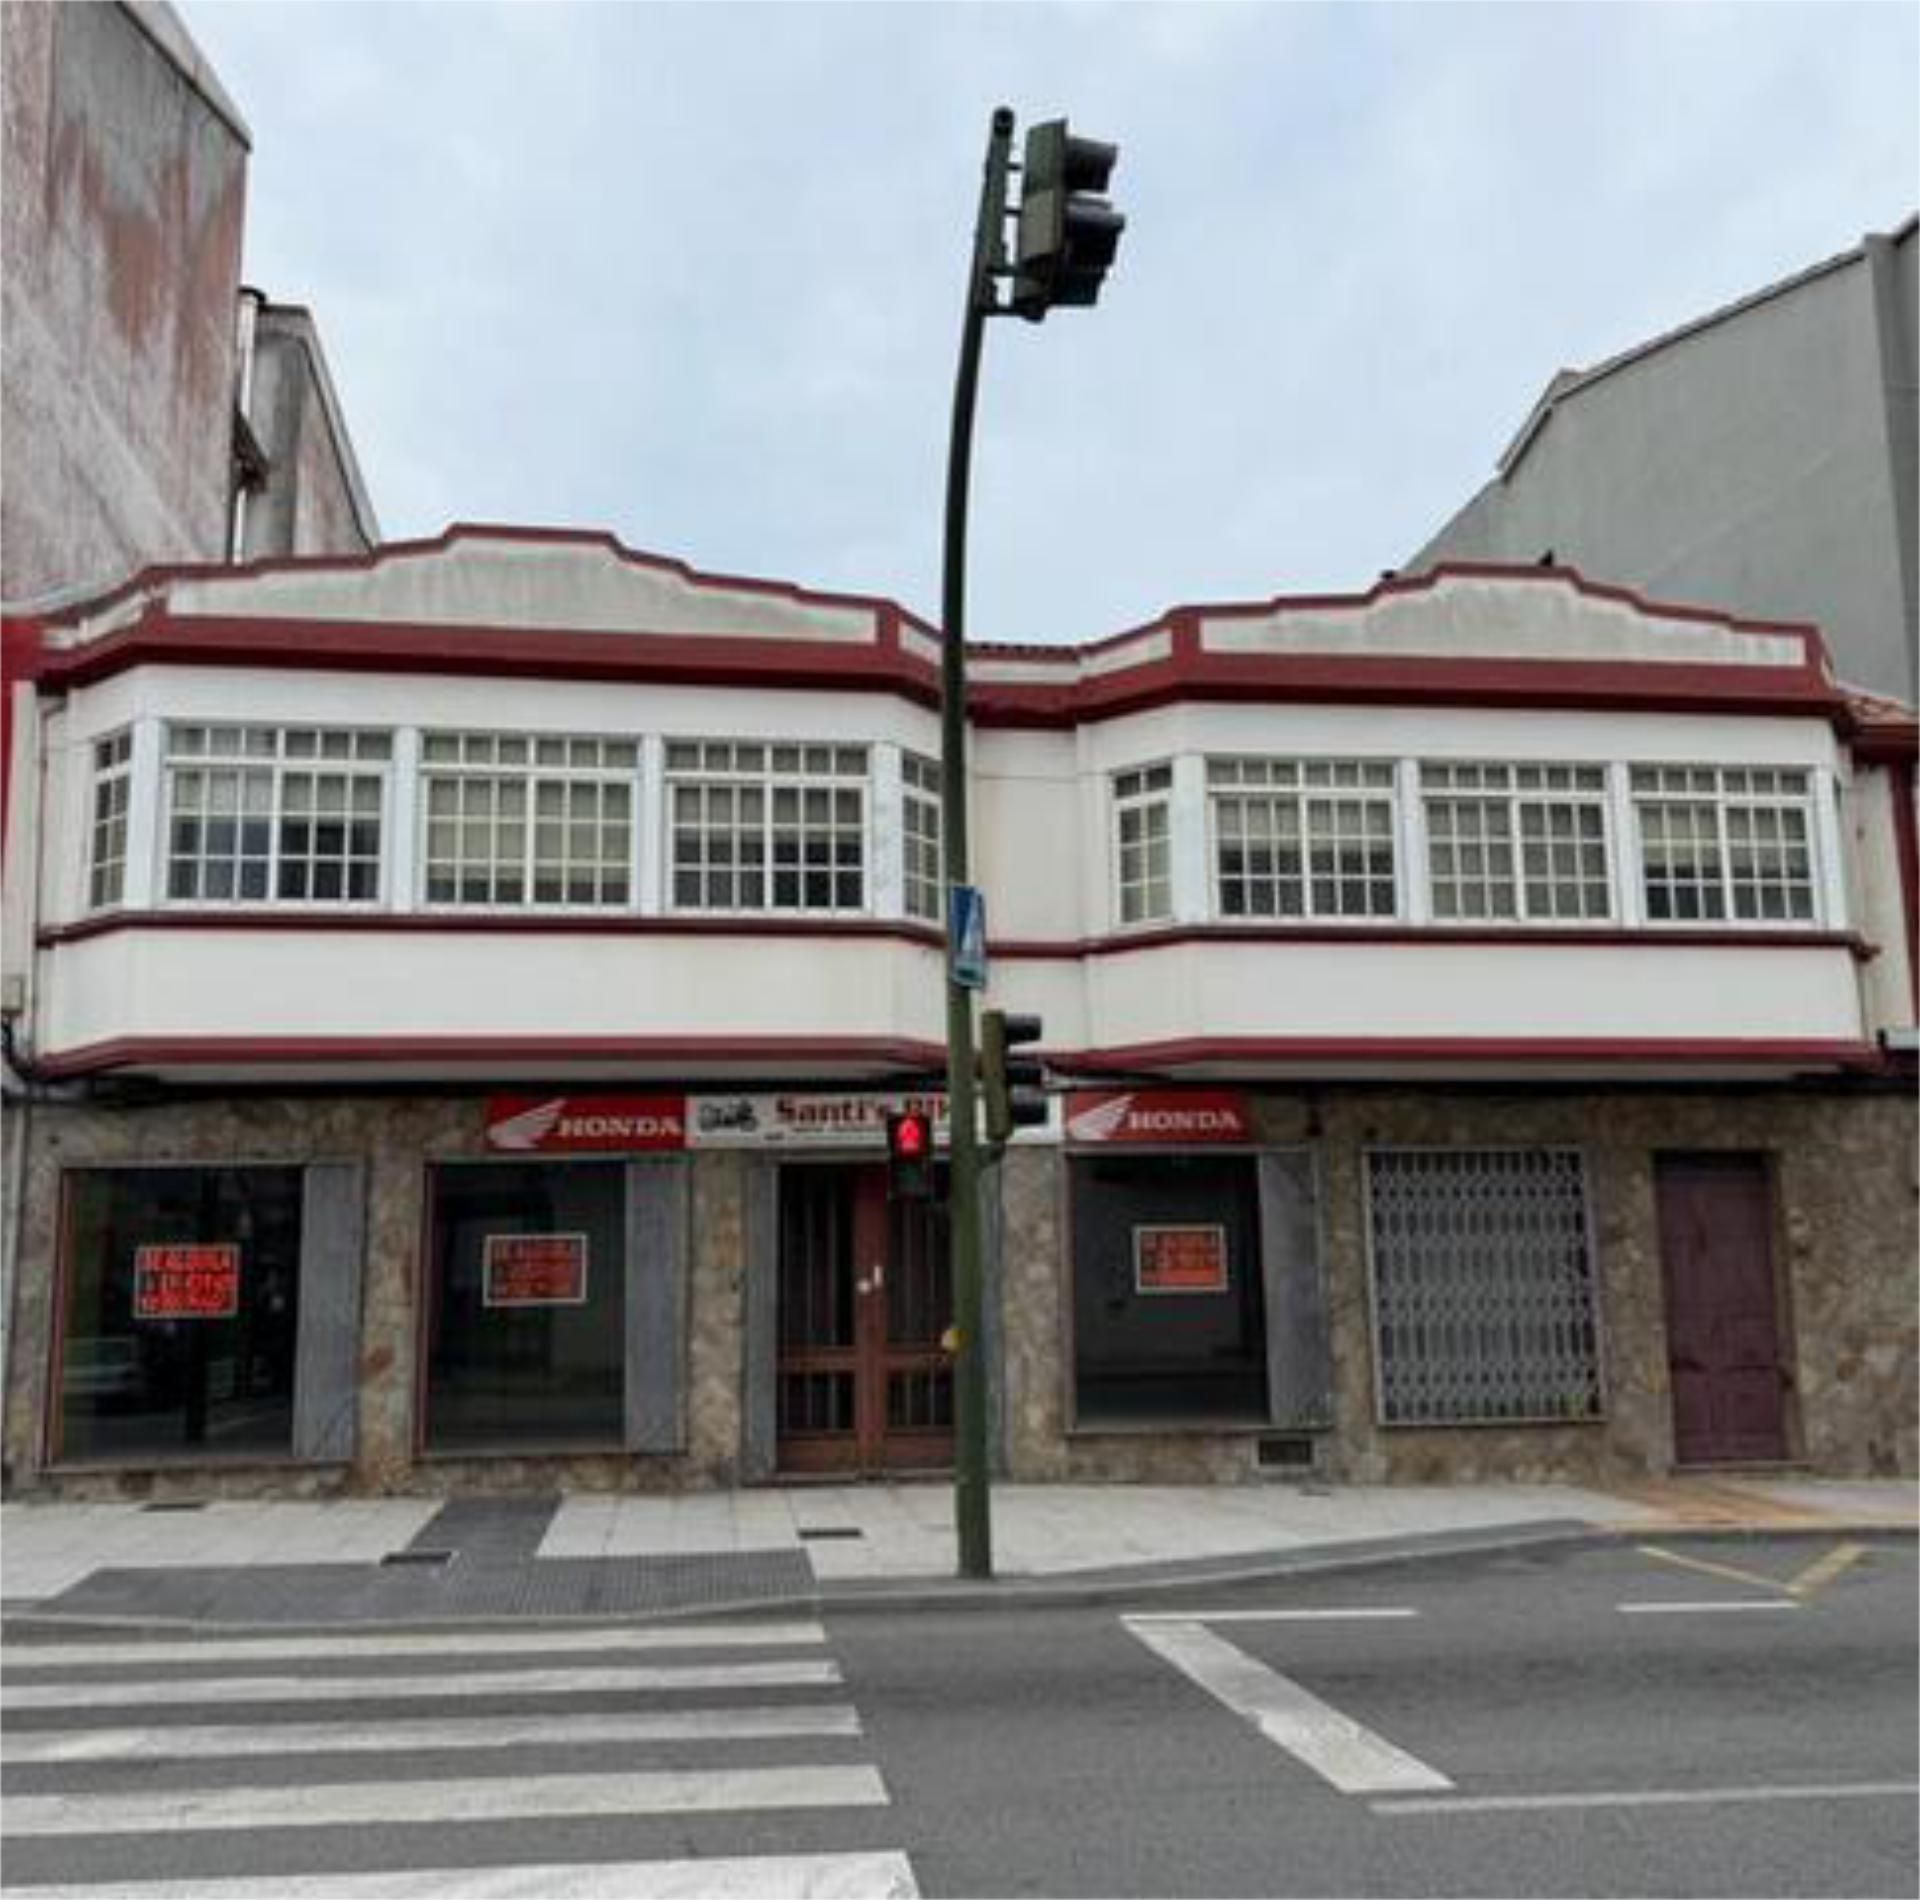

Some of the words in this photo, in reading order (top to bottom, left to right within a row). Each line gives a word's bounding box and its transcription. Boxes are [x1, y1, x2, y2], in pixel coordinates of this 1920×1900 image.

[775, 1095, 890, 1122] Santi's
[1127, 1109, 1242, 1131] HONDA
[558, 1115, 683, 1138] HONDA
